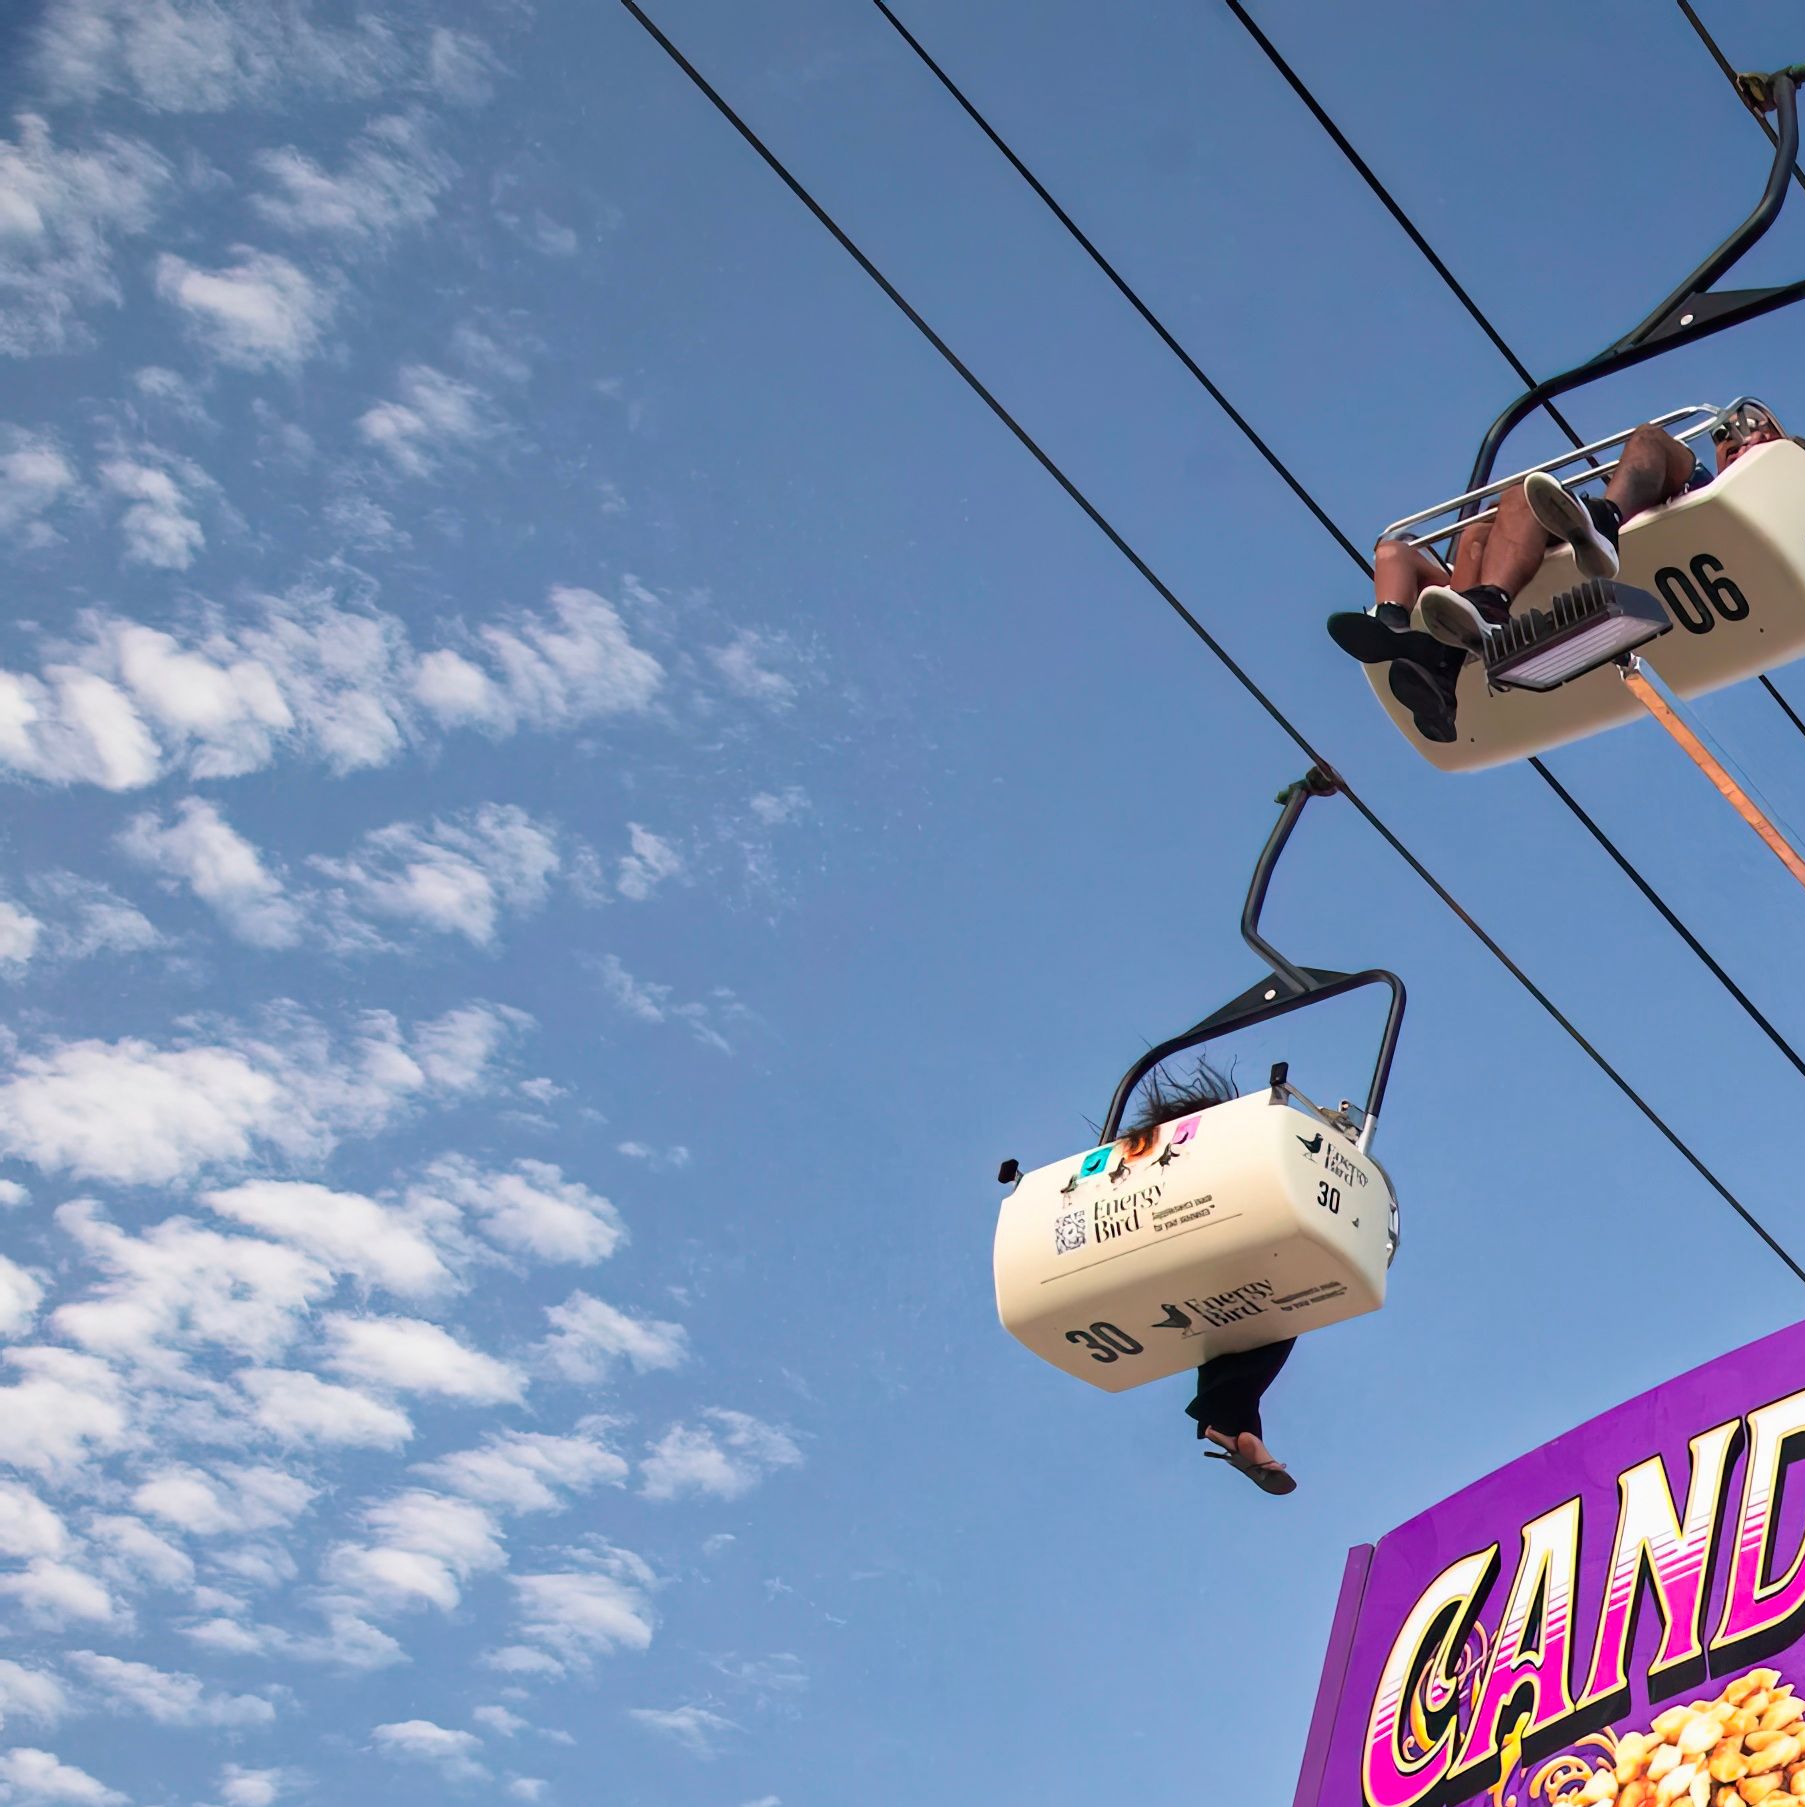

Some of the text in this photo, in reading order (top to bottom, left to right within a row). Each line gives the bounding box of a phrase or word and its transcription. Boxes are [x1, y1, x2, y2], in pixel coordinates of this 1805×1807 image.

[1653, 552, 1751, 635] 06
[1094, 1182, 1166, 1221] Energy
[1317, 1180, 1341, 1214] 30
[1094, 1209, 1143, 1243] Bird
[1184, 1279, 1275, 1317] Energy
[1202, 1299, 1268, 1327] Bird
[1065, 1321, 1144, 1363] 30
